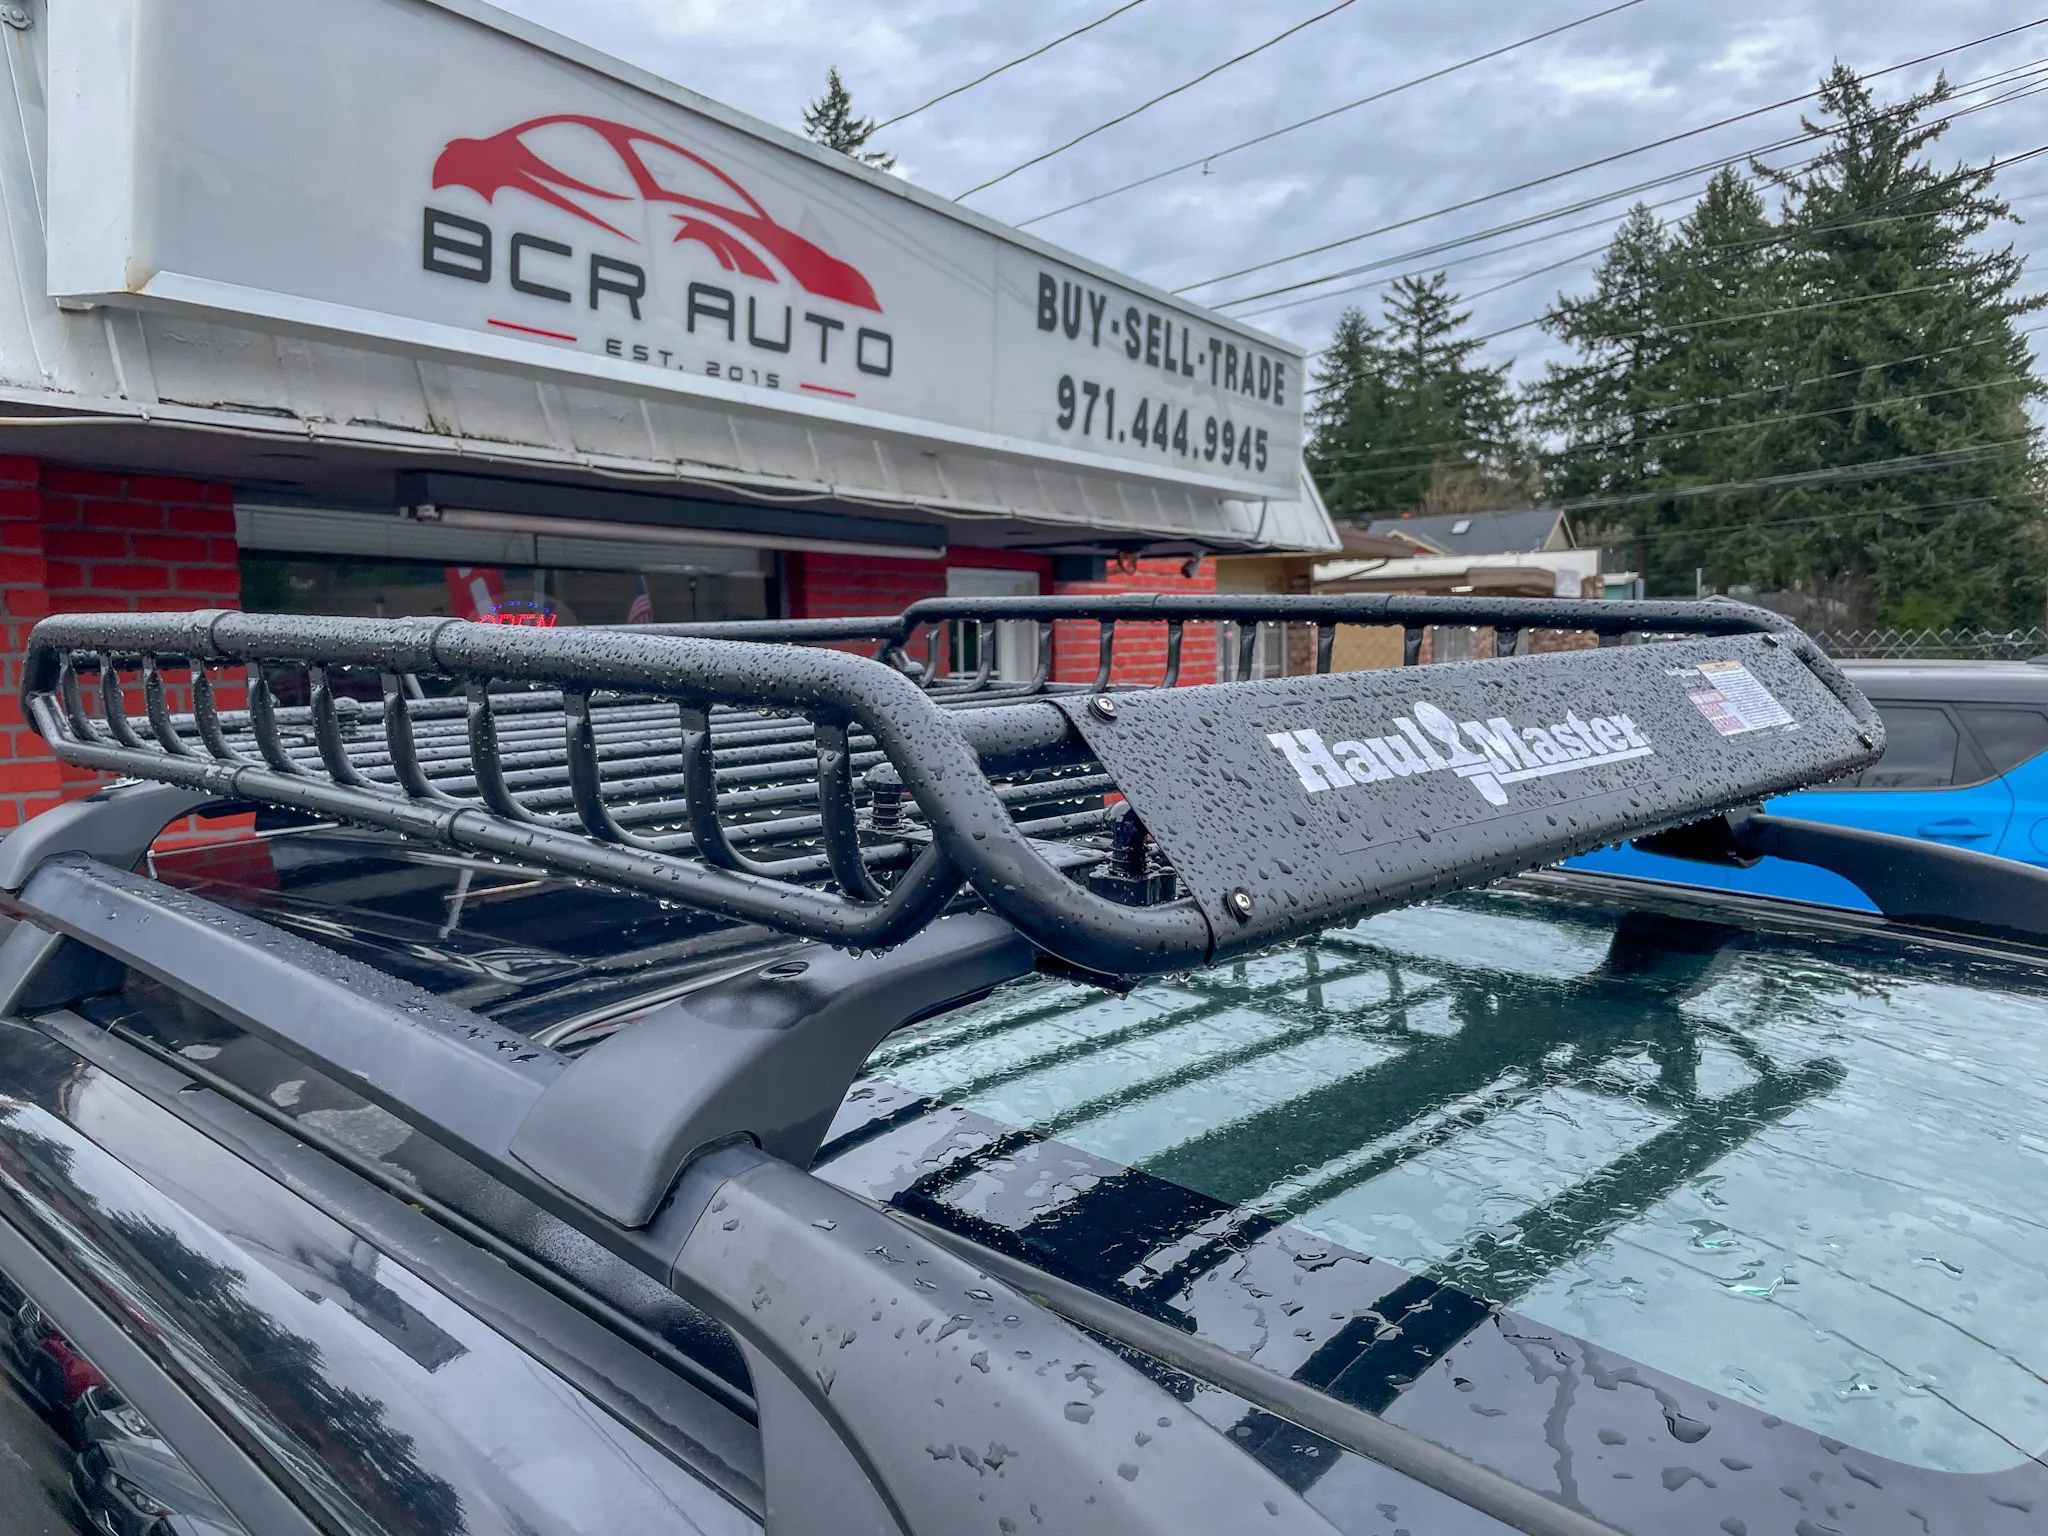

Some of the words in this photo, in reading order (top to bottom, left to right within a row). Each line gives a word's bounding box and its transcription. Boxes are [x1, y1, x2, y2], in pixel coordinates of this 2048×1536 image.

[422, 206, 646, 320] BCR
[686, 281, 894, 378] AUTO
[605, 337, 684, 371] EST.
[705, 360, 780, 389] 2015
[1056, 373, 1269, 473] 971.444.9945
